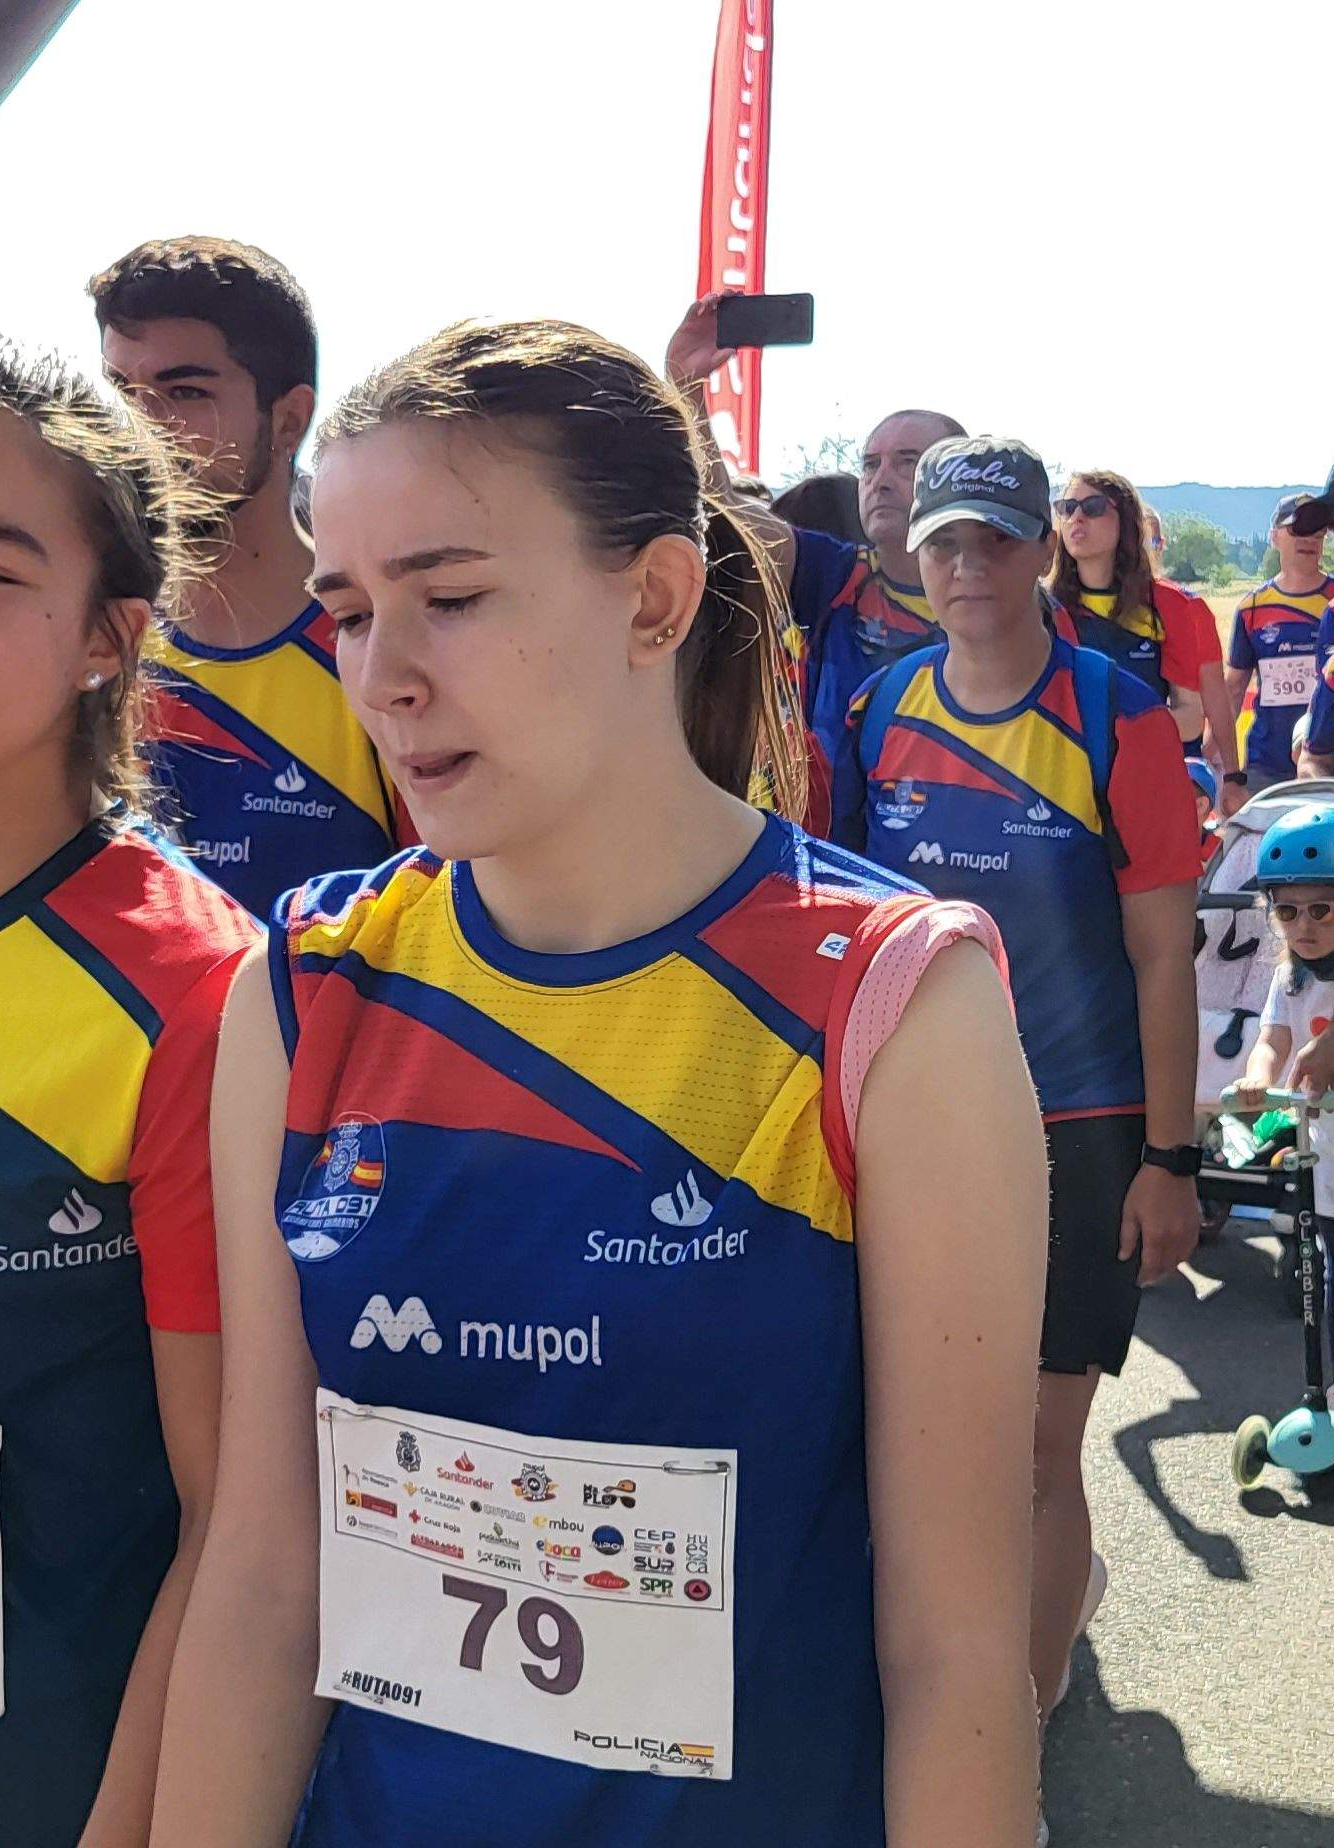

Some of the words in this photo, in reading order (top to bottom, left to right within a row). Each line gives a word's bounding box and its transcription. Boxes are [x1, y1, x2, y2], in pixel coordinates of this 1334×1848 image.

[929, 453, 1021, 489] Italia
[951, 482, 995, 494] Original
[1273, 680, 1305, 695] 590
[242, 792, 337, 818] Santander
[1001, 820, 1072, 838] Santander
[950, 852, 1010, 873] mupol
[335, 1196, 373, 1215] 091
[583, 1227, 749, 1265] Santander
[1298, 1210, 1315, 1326] GLOBBER
[460, 1315, 602, 1373] mupol
[437, 1467, 494, 1491] Santander
[424, 1516, 440, 1528] Cruz
[443, 1522, 461, 1533] Roja
[634, 1528, 676, 1541] CEP
[633, 1556, 674, 1570] SUP
[639, 1577, 673, 1593] SPP
[441, 1573, 584, 1695] 79
[341, 1669, 422, 1707] #RUTA091
[573, 1730, 684, 1756] POLICIA
[640, 1750, 713, 1768] NACIONAL
